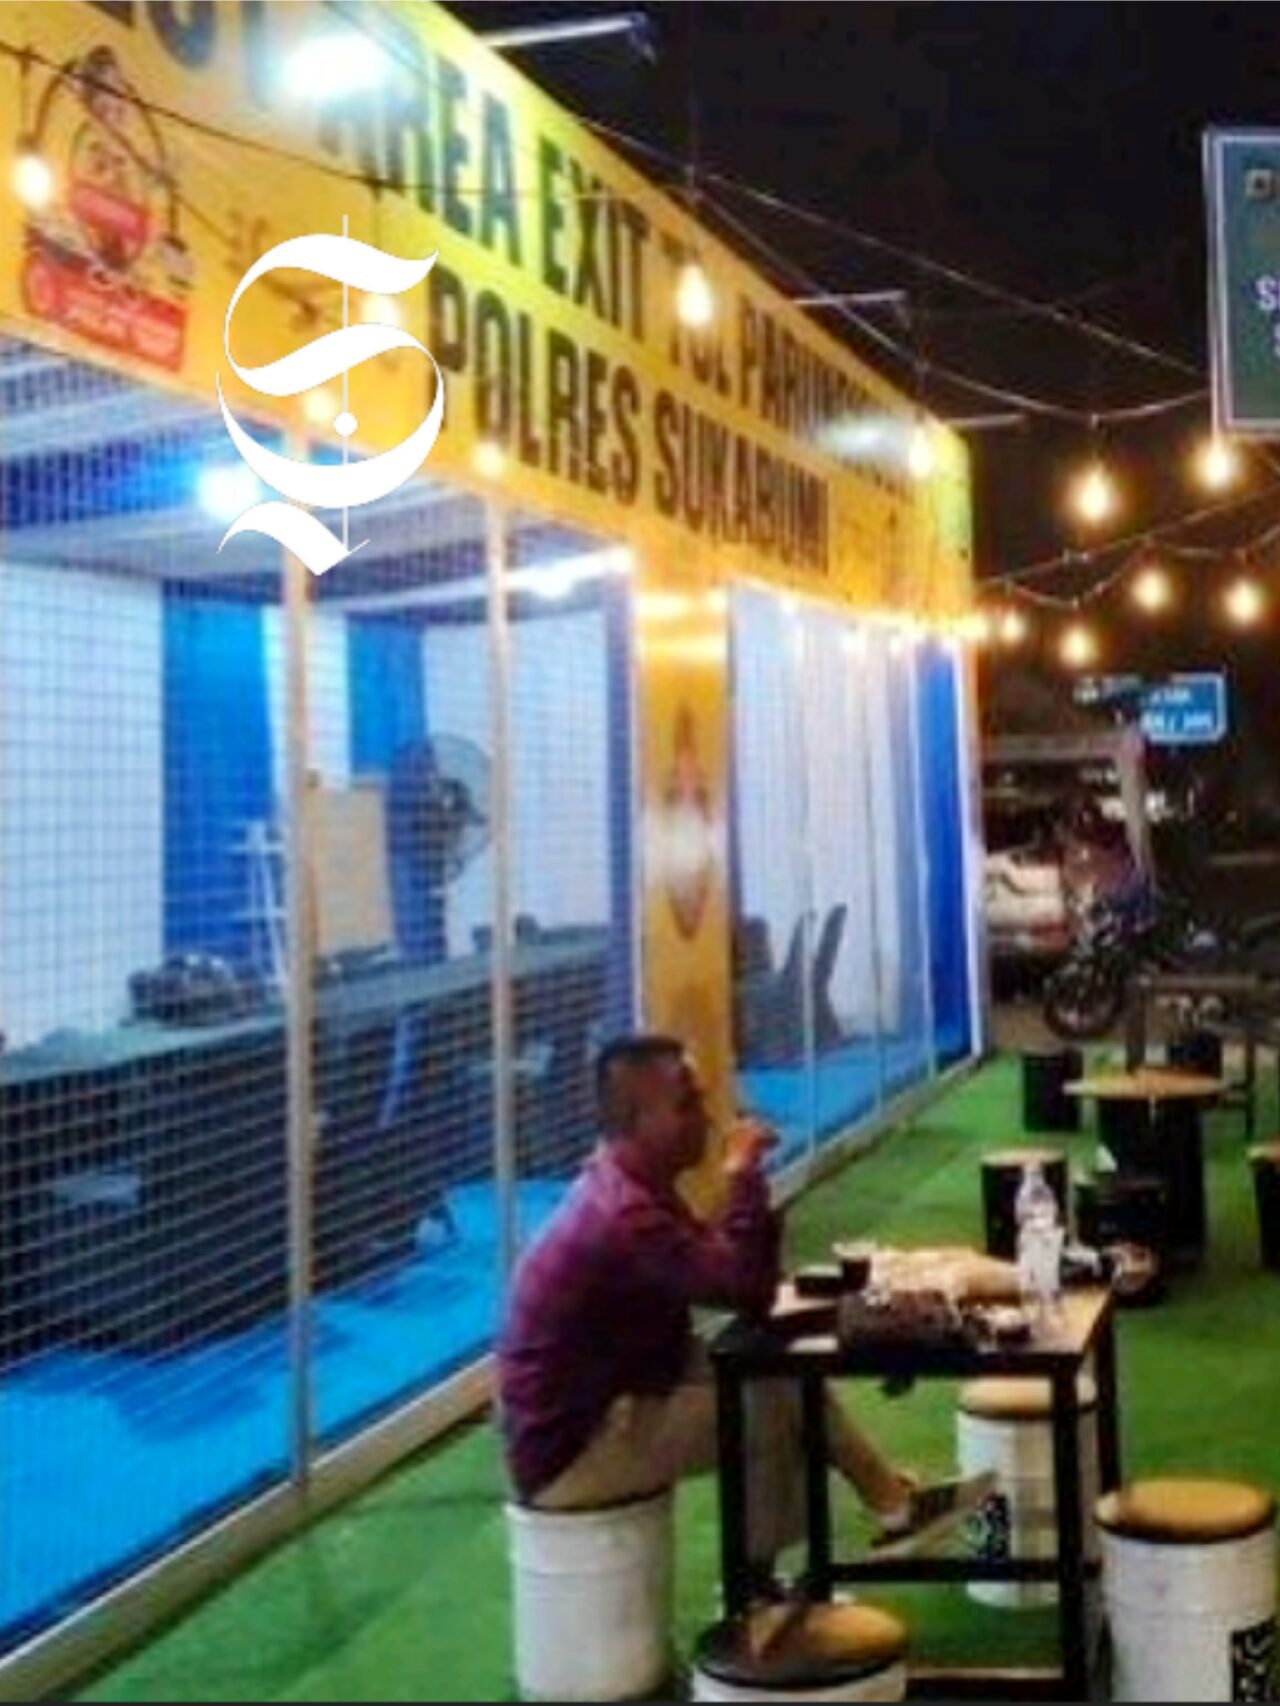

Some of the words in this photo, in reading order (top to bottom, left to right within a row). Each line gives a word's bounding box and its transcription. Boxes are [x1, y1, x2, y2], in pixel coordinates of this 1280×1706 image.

[538, 130, 650, 342] EXIT
[427, 262, 640, 506] POLRES
[653, 388, 829, 577] SUKABUMI
